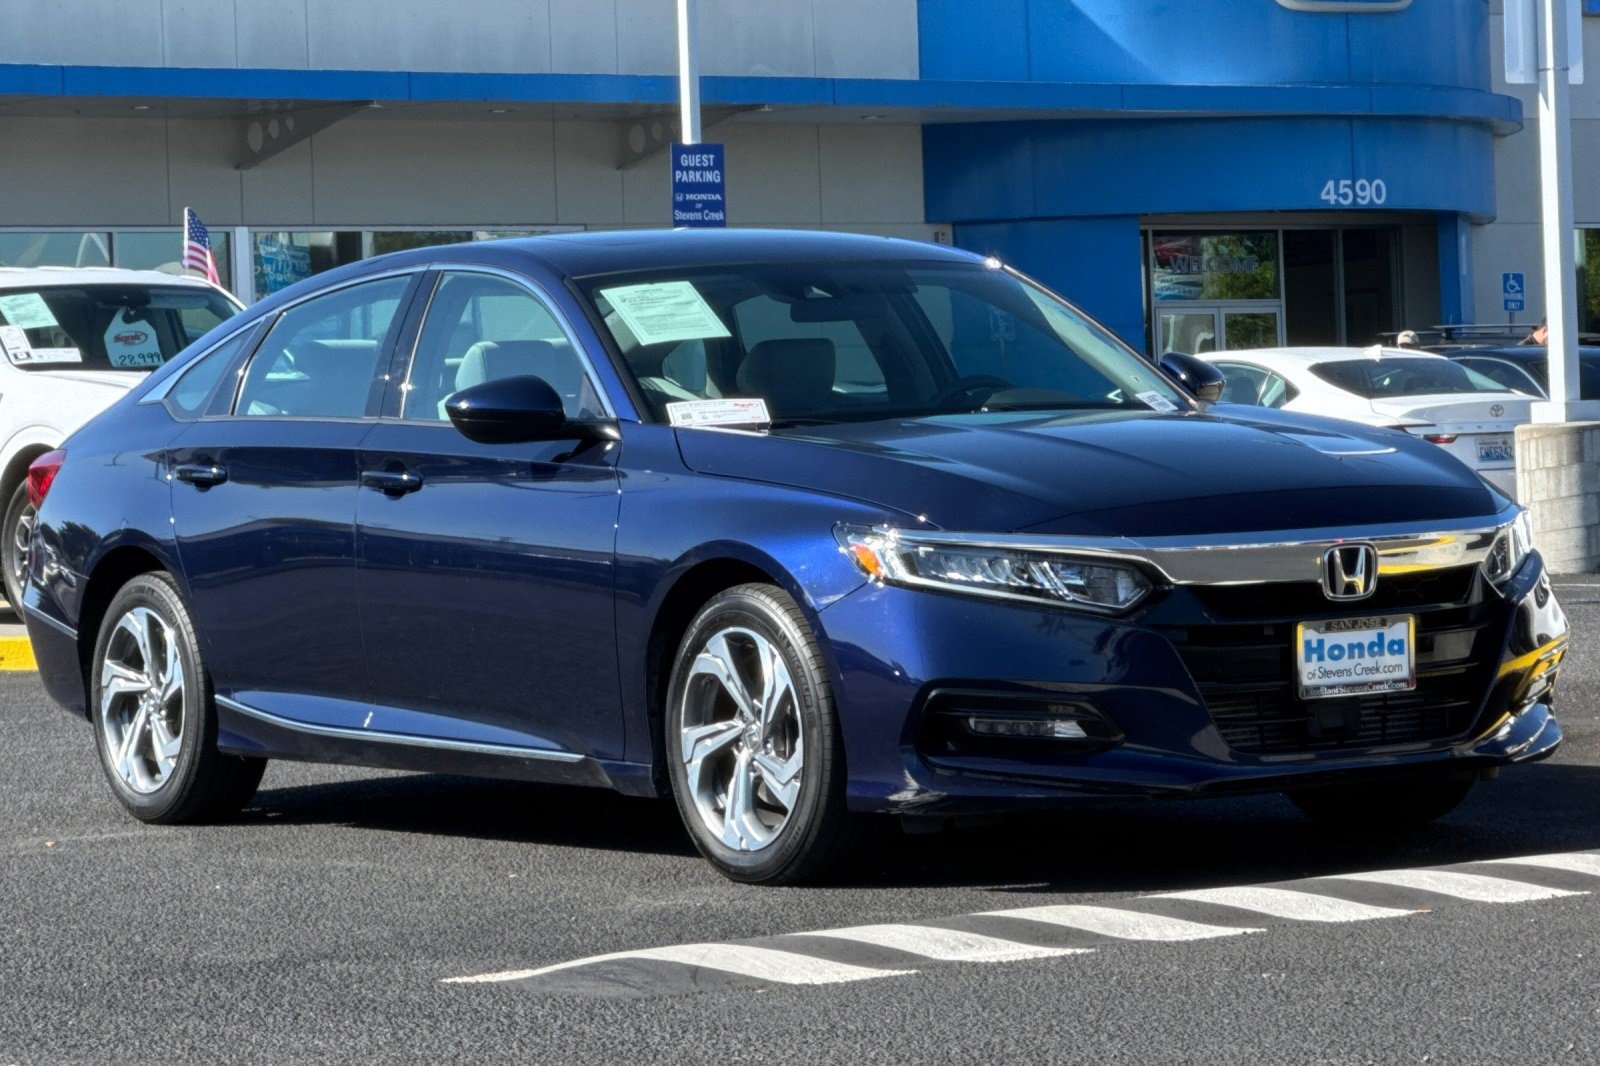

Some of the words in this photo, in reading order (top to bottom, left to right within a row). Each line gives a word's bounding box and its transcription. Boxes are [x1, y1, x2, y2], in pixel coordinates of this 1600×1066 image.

[680, 154, 715, 167] GUEST
[675, 170, 721, 183] PARKING
[685, 193, 722, 201] HONDA
[1320, 178, 1387, 206] 4590
[674, 209, 702, 221] Stevens
[703, 209, 725, 221] Creek
[1168, 255, 1259, 275] WELCOME
[1330, 619, 1353, 631] SAN
[1303, 632, 1405, 663] Honda
[1306, 669, 1316, 681] of
